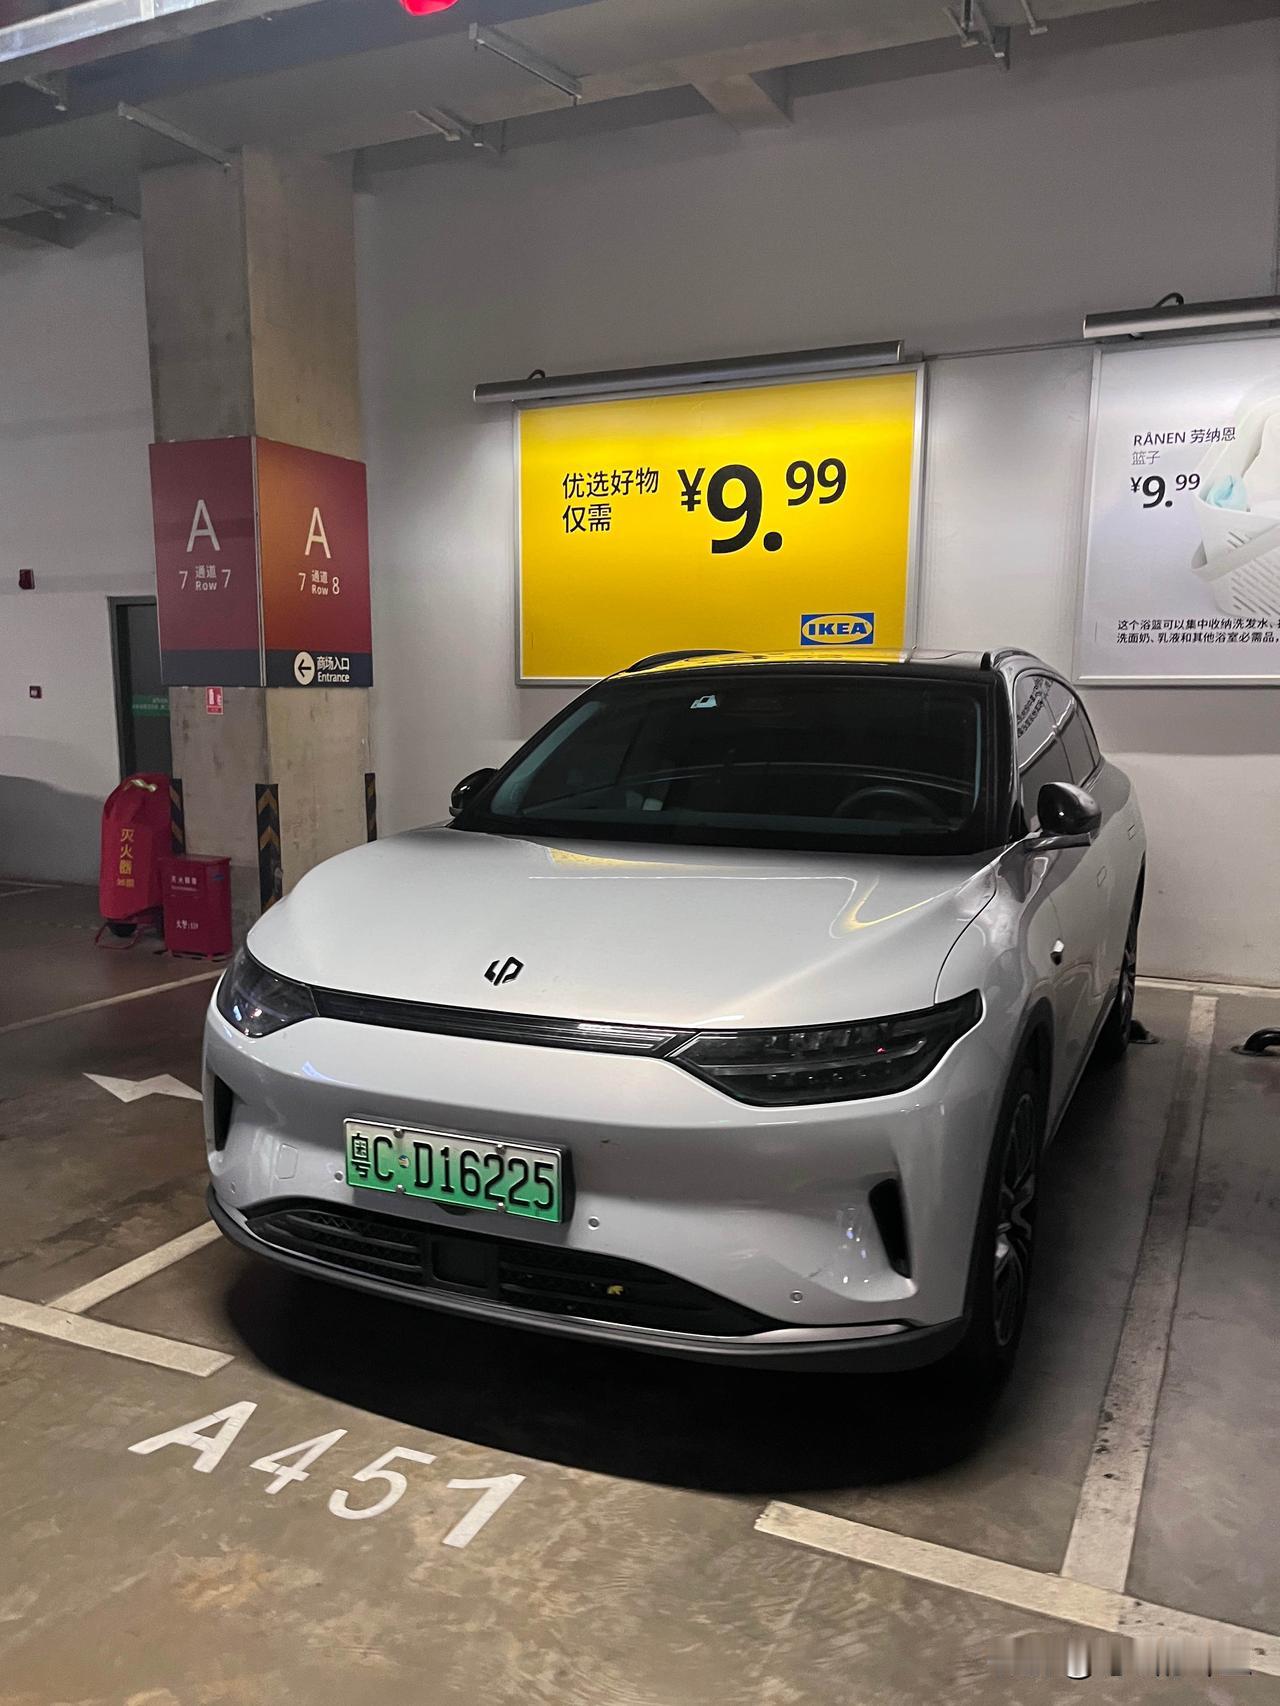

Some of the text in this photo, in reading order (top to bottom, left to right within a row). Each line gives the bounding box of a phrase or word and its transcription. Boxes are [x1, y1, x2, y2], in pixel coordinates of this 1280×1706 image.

[1133, 427, 1236, 446] RÅNEN 劳纳恩
[1132, 450, 1160, 465] 篮子
[562, 467, 660, 499] 优选好物
[186, 499, 221, 553] A
[562, 502, 612, 533] 仅需
[304, 506, 332, 559] A
[178, 565, 232, 590] 7 通道 7
[195, 581, 217, 591] Row
[298, 569, 340, 595] 7 通道 8
[311, 584, 329, 596] Row
[808, 622, 868, 636] IKEA
[1117, 617, 1280, 630] 这个浴篮可以集中收纳洗发水、
[316, 656, 350, 671] 商场入口
[317, 671, 350, 683] Entrance
[127, 1401, 527, 1549] A451
